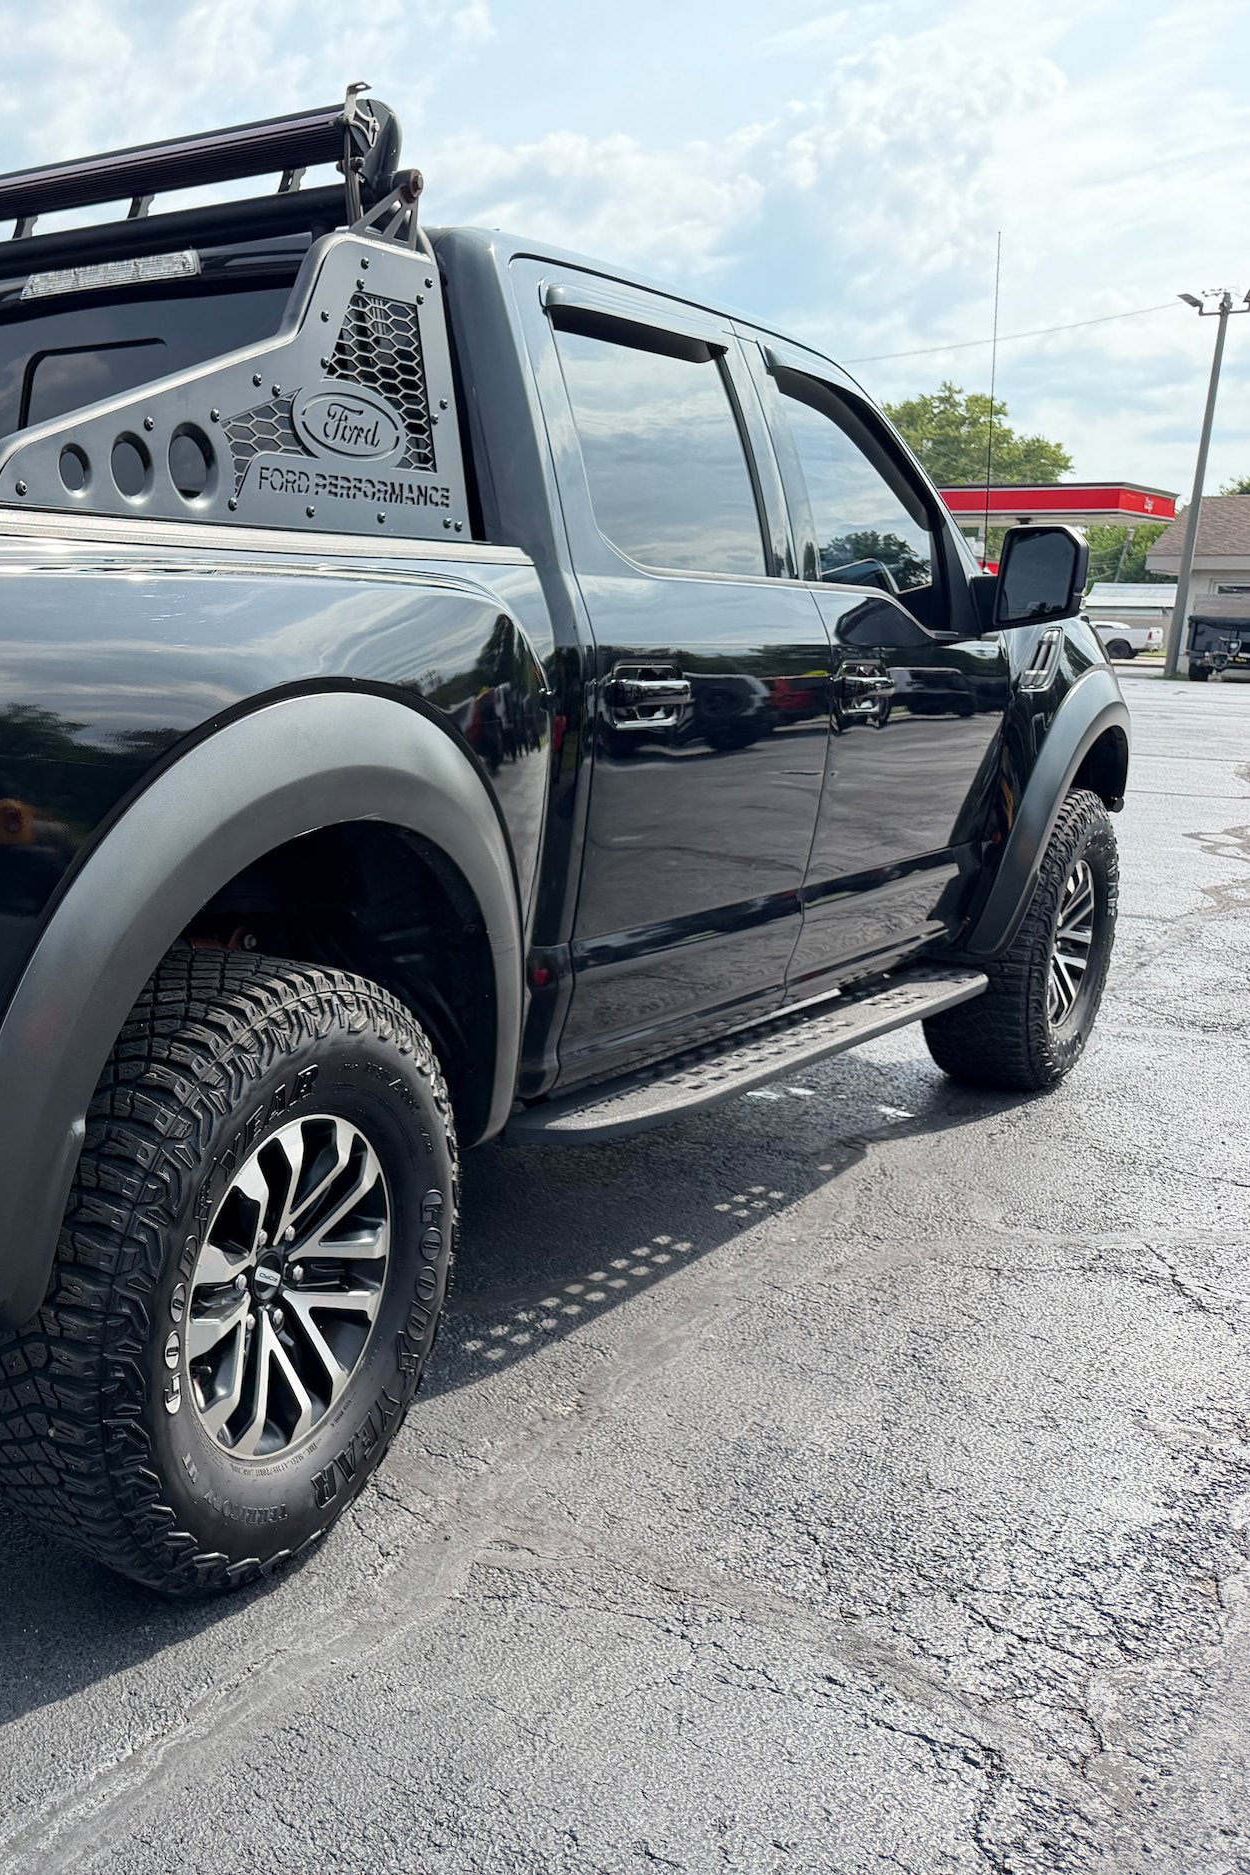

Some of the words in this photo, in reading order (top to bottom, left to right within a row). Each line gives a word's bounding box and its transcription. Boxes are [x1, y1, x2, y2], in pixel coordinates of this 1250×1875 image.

[323, 402, 381, 448] Ford
[258, 466, 311, 496] FORD
[314, 472, 451, 509] PERFORMANCE
